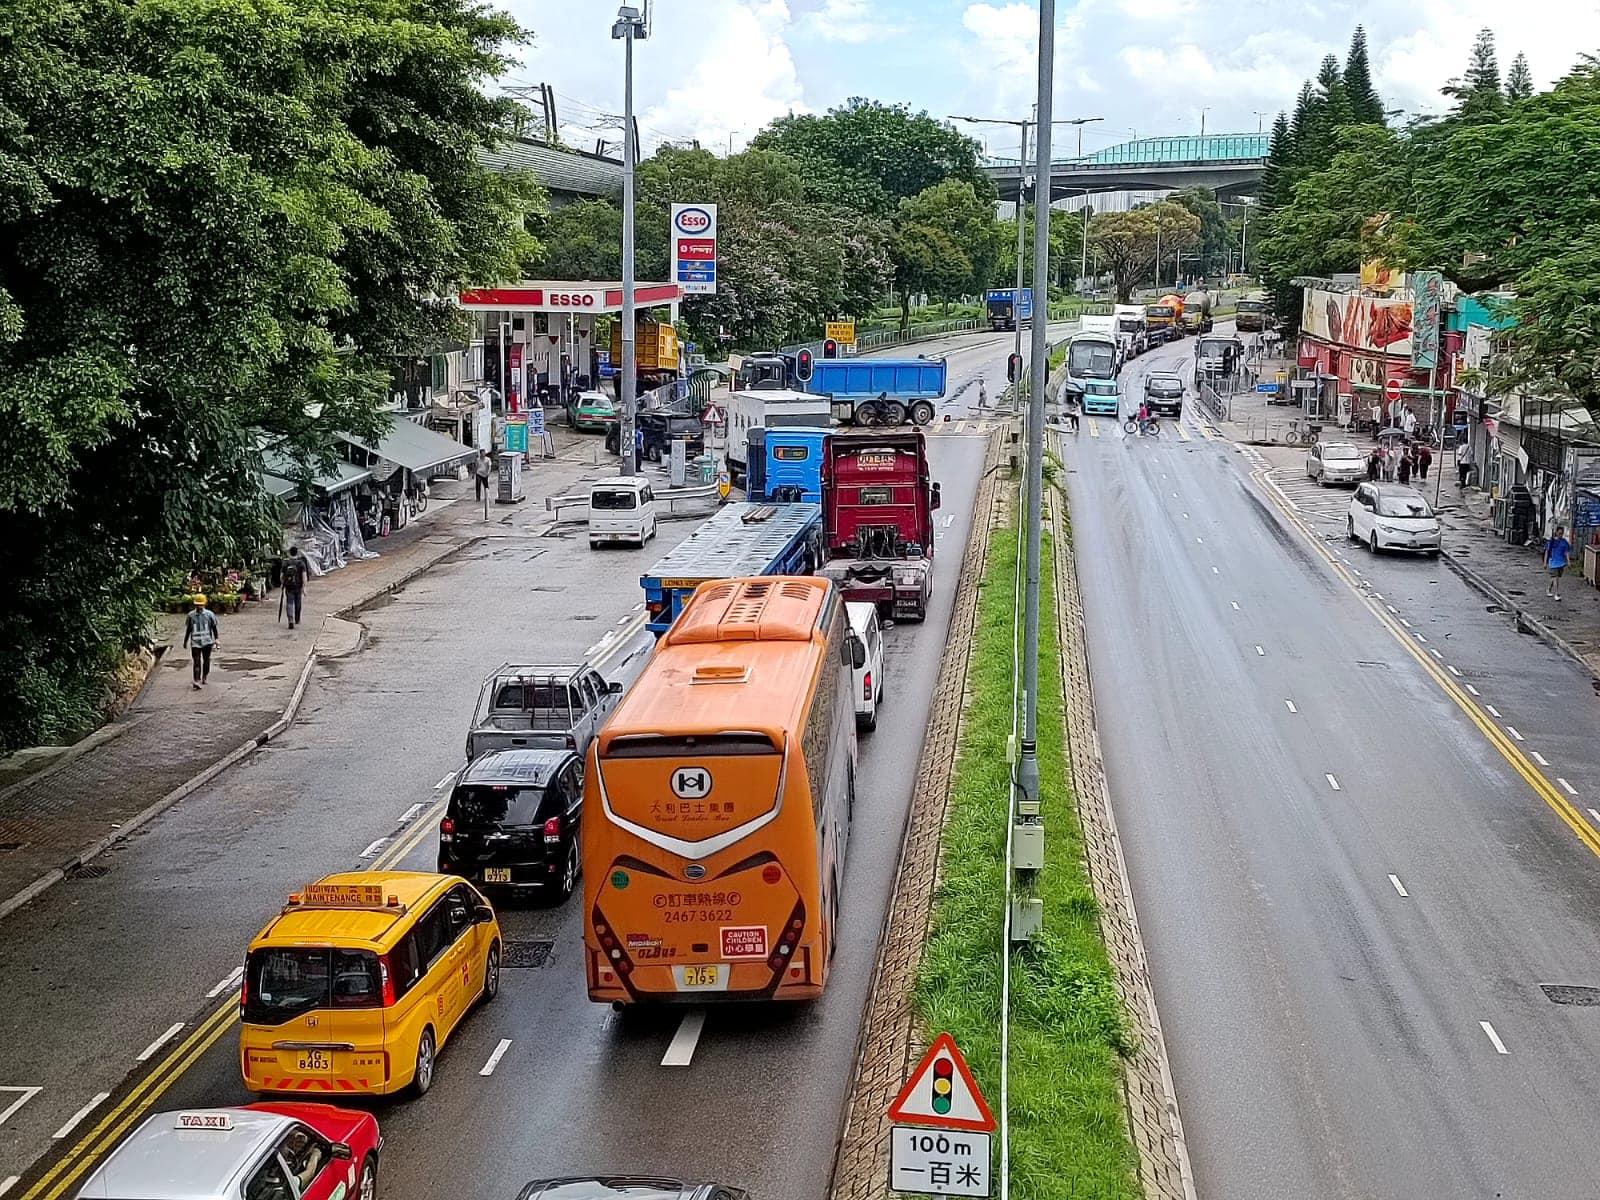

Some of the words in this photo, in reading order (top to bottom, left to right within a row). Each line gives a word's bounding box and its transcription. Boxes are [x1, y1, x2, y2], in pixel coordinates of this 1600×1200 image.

[681, 214, 706, 226] Esso
[549, 293, 594, 306] ESSO
[305, 894, 361, 903] MAINTENANCE
[664, 910, 696, 923] 2467
[699, 909, 733, 922] 3622
[299, 1060, 329, 1070] 8403
[180, 1115, 226, 1127] TAXI
[900, 1161, 981, 1188] 一百米
